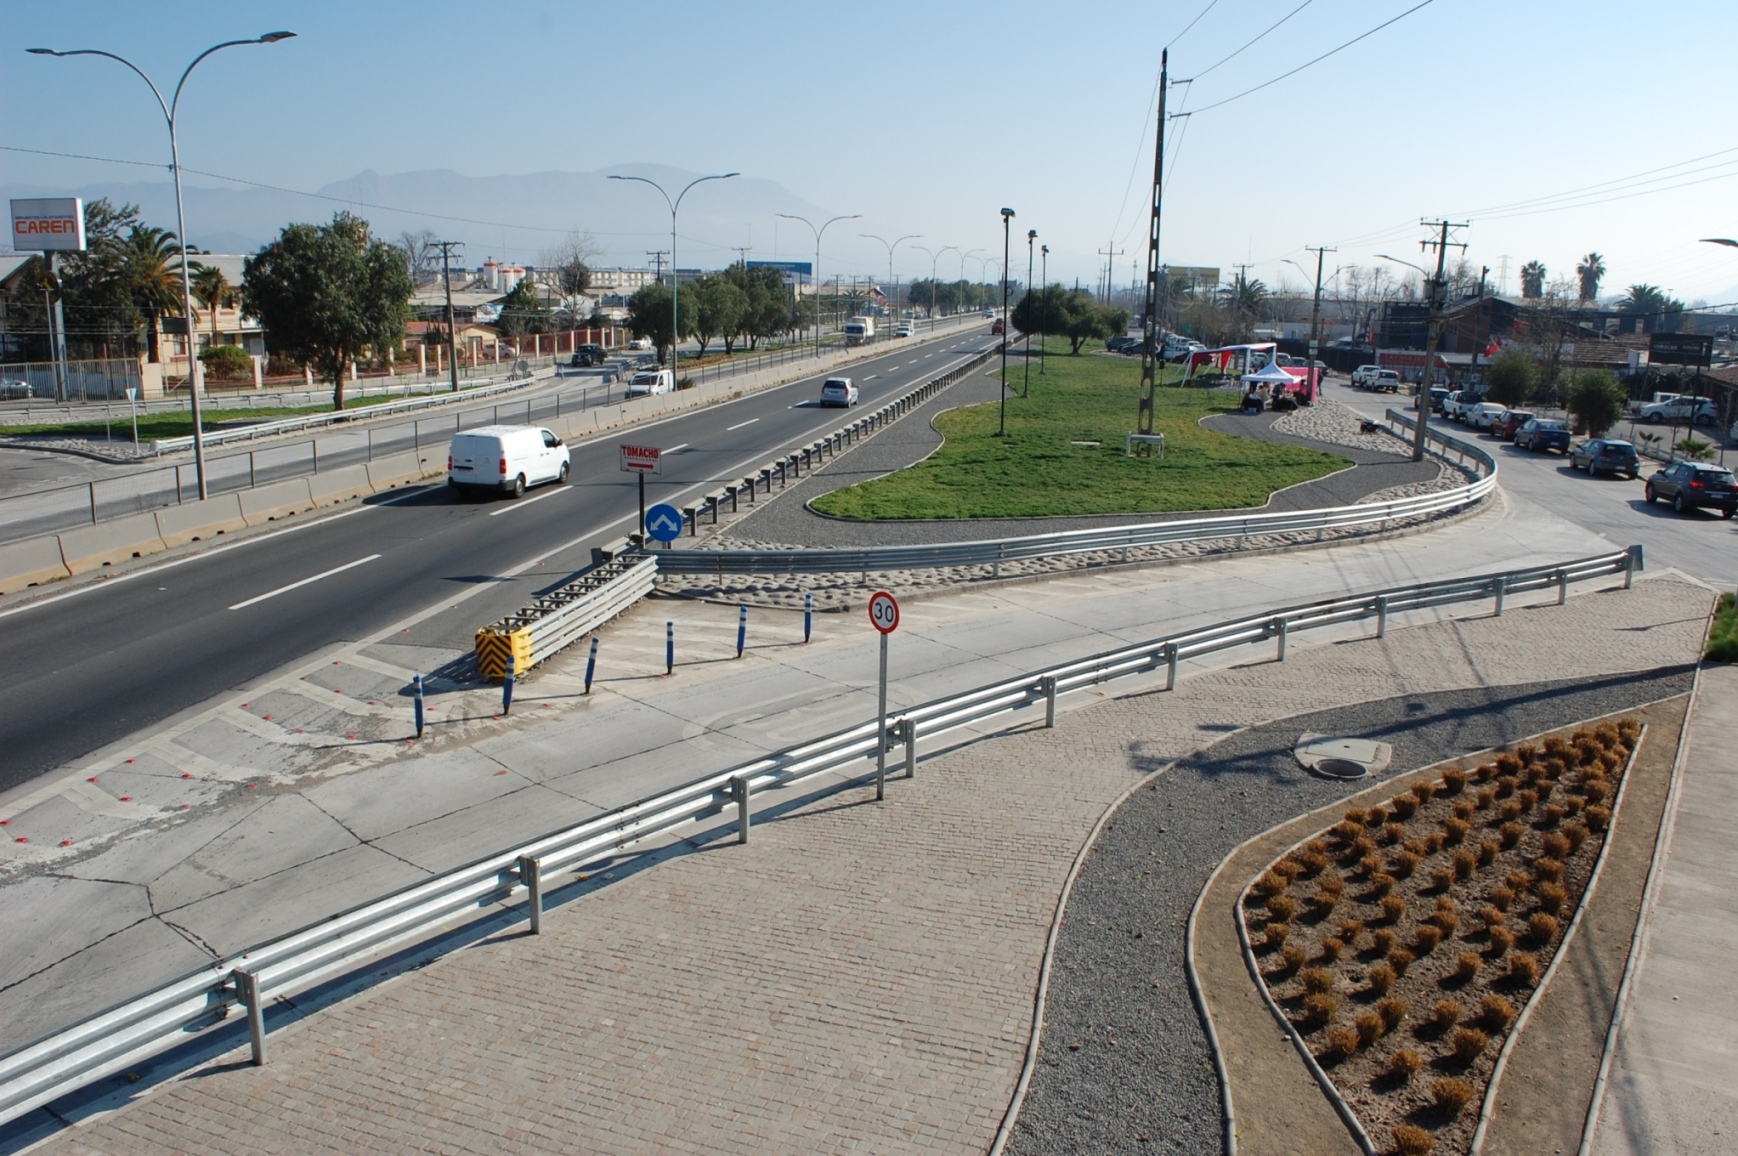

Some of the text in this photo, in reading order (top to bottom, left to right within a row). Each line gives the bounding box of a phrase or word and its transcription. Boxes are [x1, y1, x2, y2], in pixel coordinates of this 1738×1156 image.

[15, 220, 75, 234] CAREN
[621, 446, 659, 459] TOMACHO
[874, 602, 894, 623] 30
